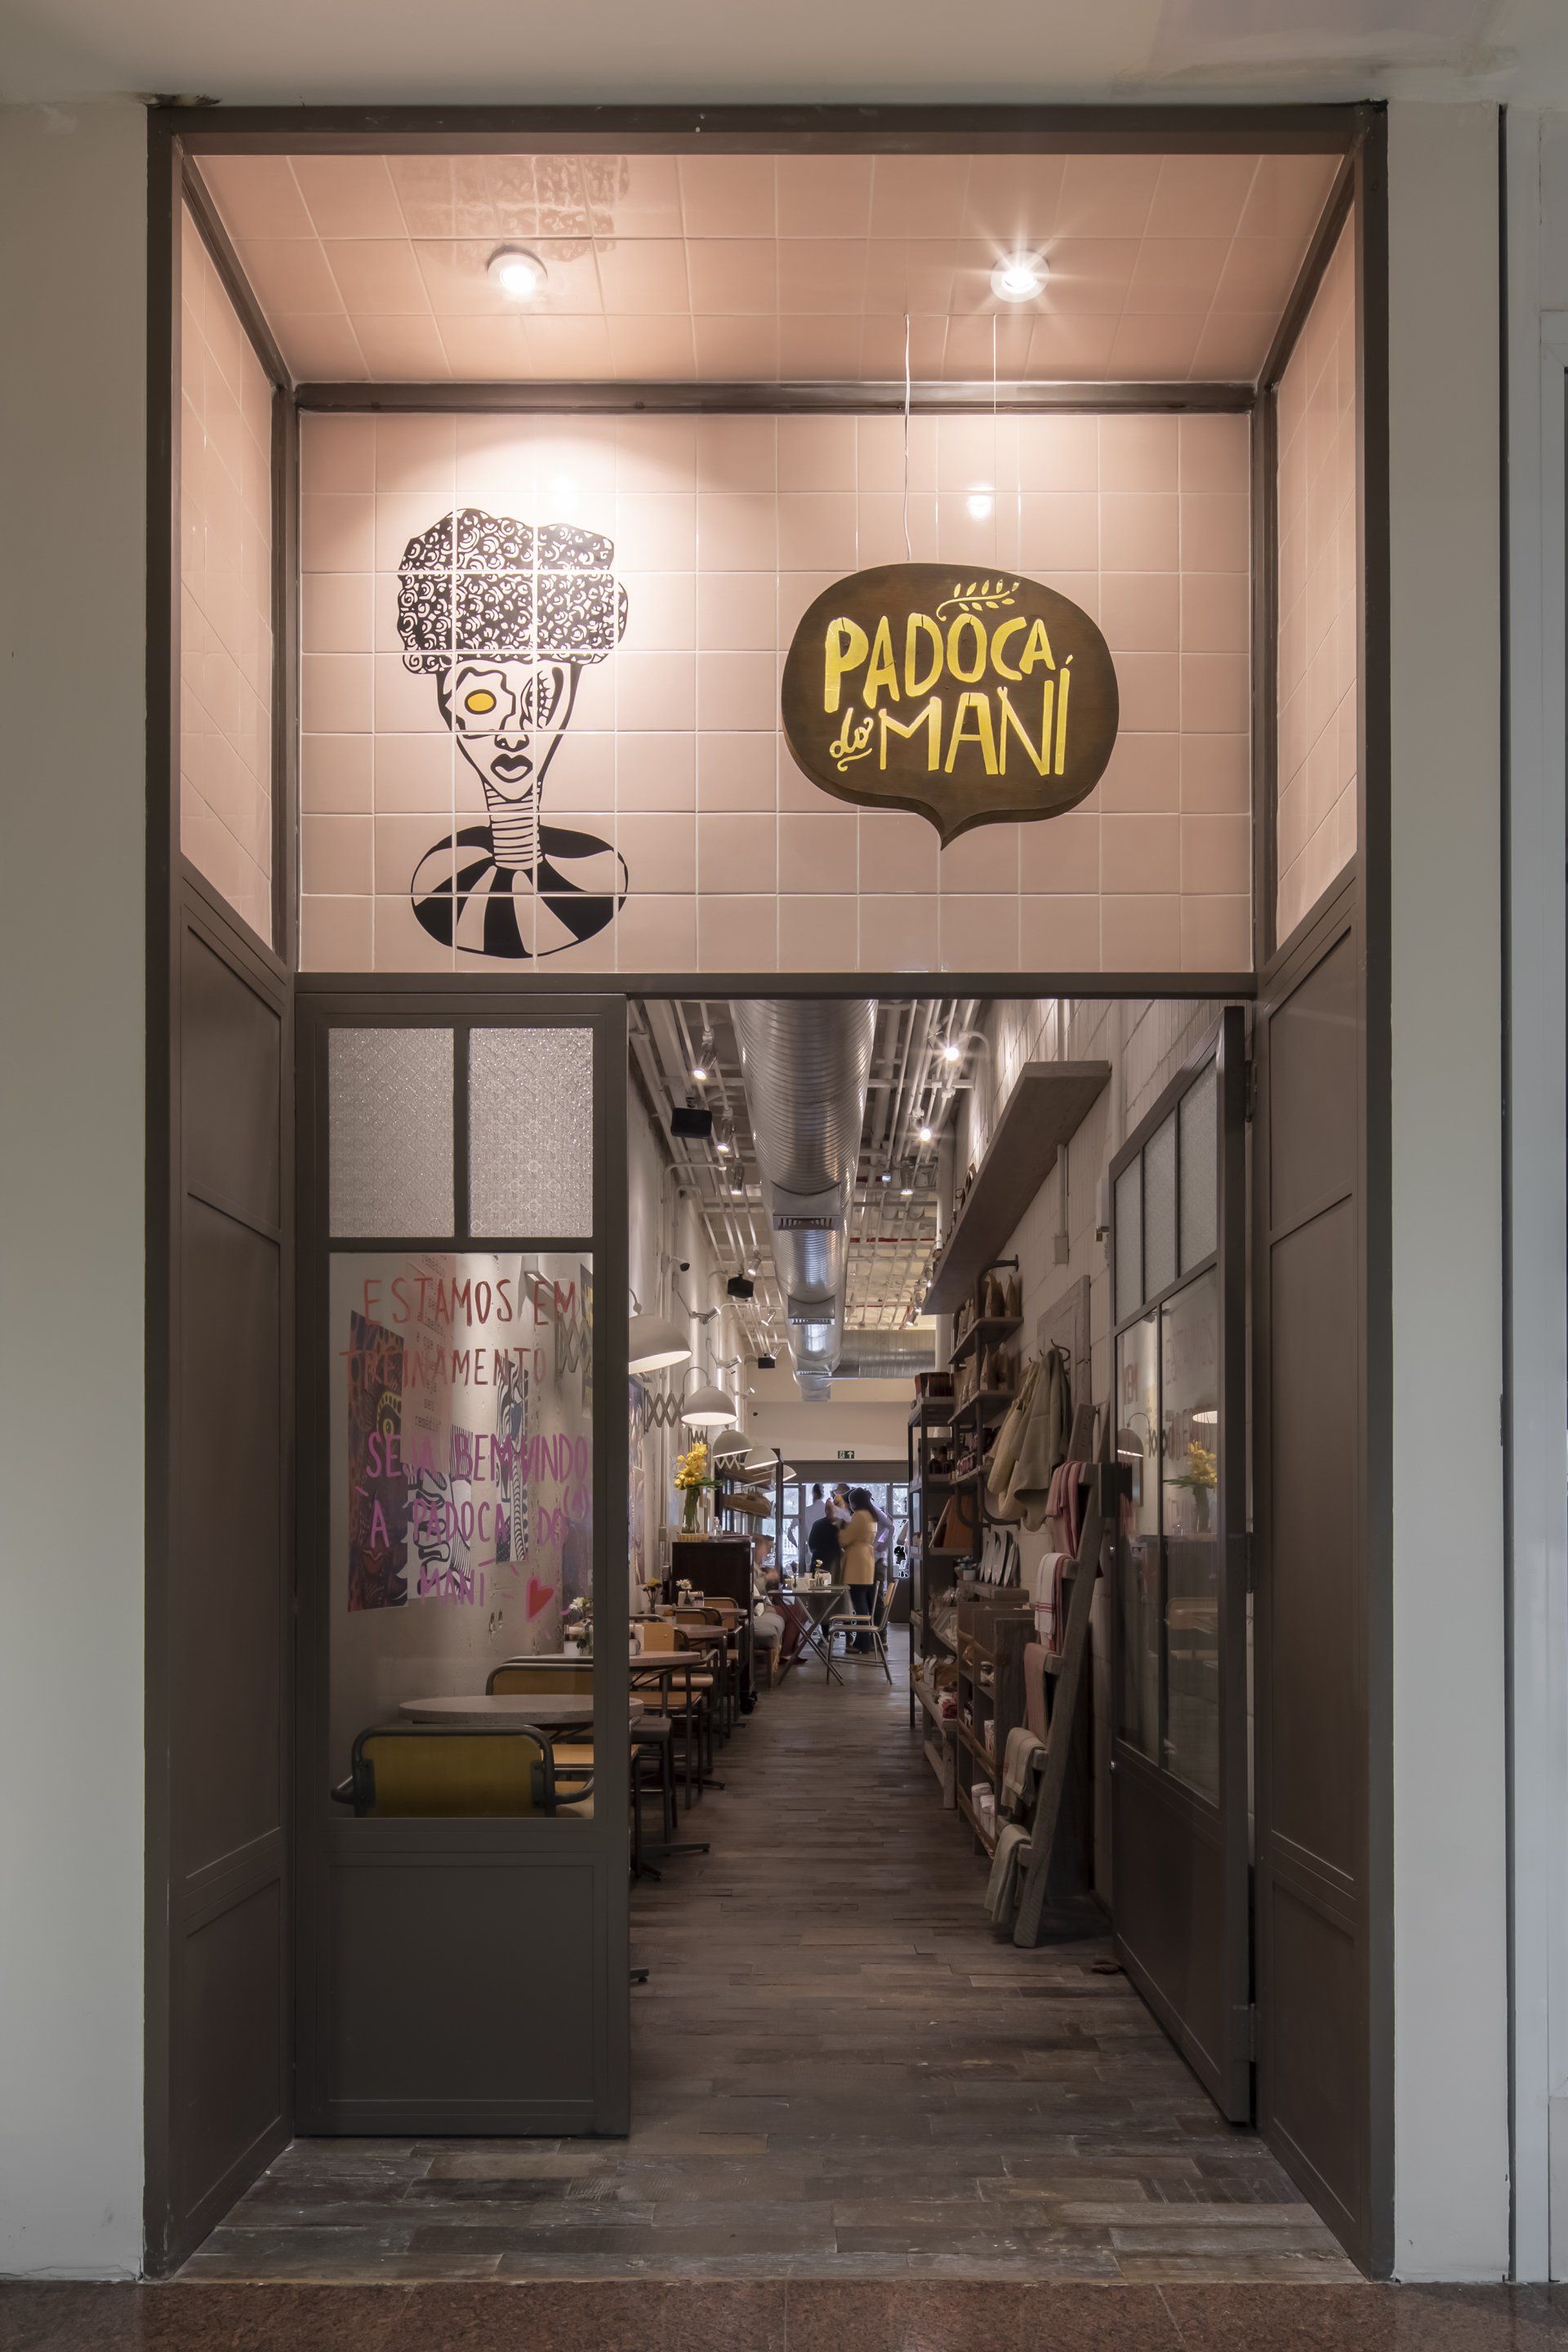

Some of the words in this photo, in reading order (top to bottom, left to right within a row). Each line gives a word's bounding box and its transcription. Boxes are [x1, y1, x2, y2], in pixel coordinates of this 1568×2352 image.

[824, 612, 1056, 713] PADOCA
[829, 706, 874, 763] do
[879, 654, 1074, 777] MANÍ
[363, 1277, 513, 1327] ESTAMOS
[534, 1280, 576, 1326] EM
[339, 1347, 548, 1388] TREINAMENTO
[365, 1431, 435, 1481] SEJA
[412, 1497, 508, 1544] PADOCA
